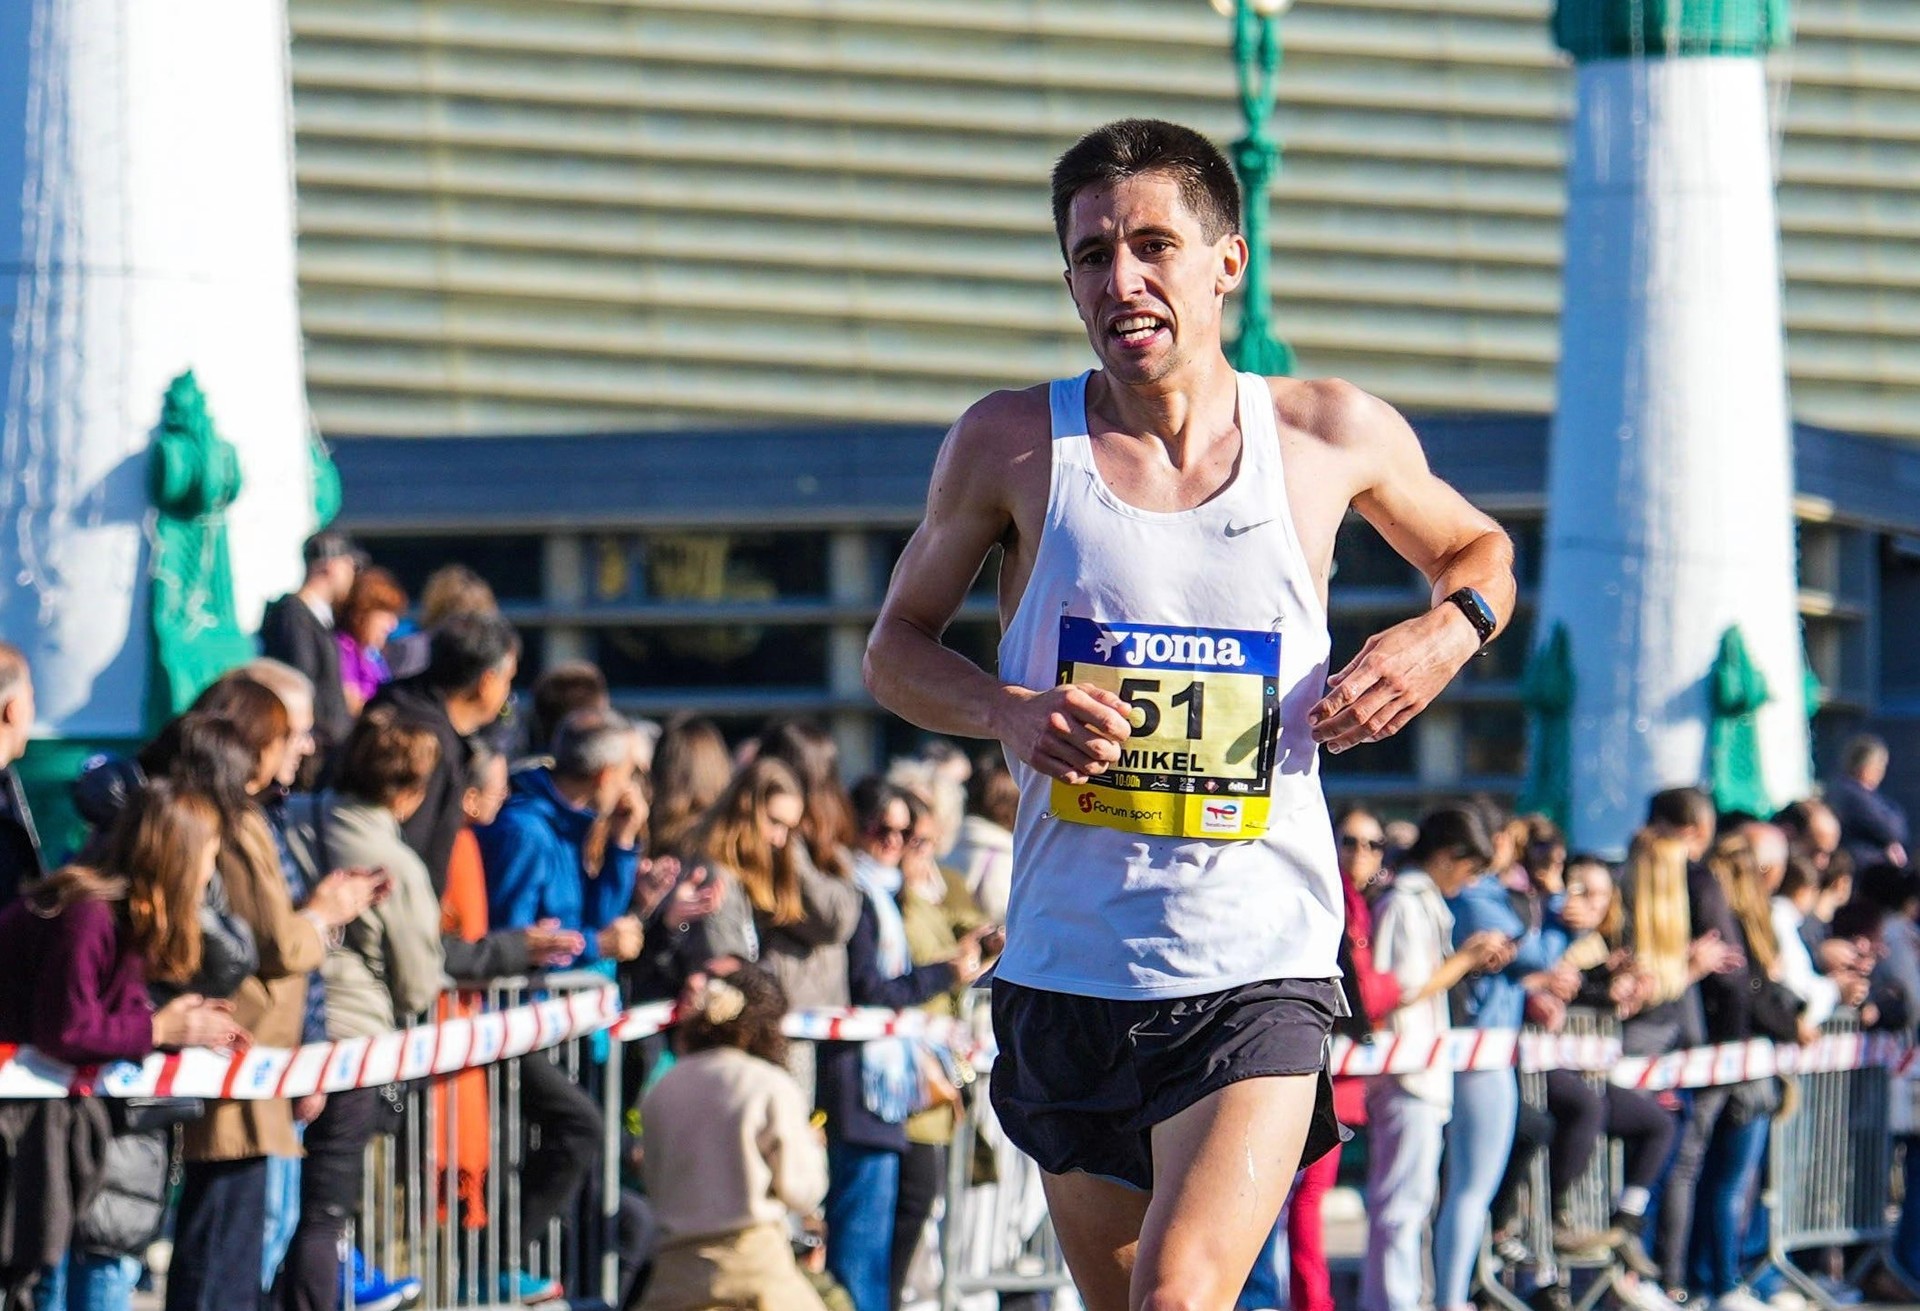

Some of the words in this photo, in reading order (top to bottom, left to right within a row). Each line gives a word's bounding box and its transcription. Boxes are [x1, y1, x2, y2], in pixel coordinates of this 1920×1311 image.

[1118, 678, 1205, 740] 51
[1118, 749, 1204, 772] MIKEL
[1130, 809, 1162, 822] sport
